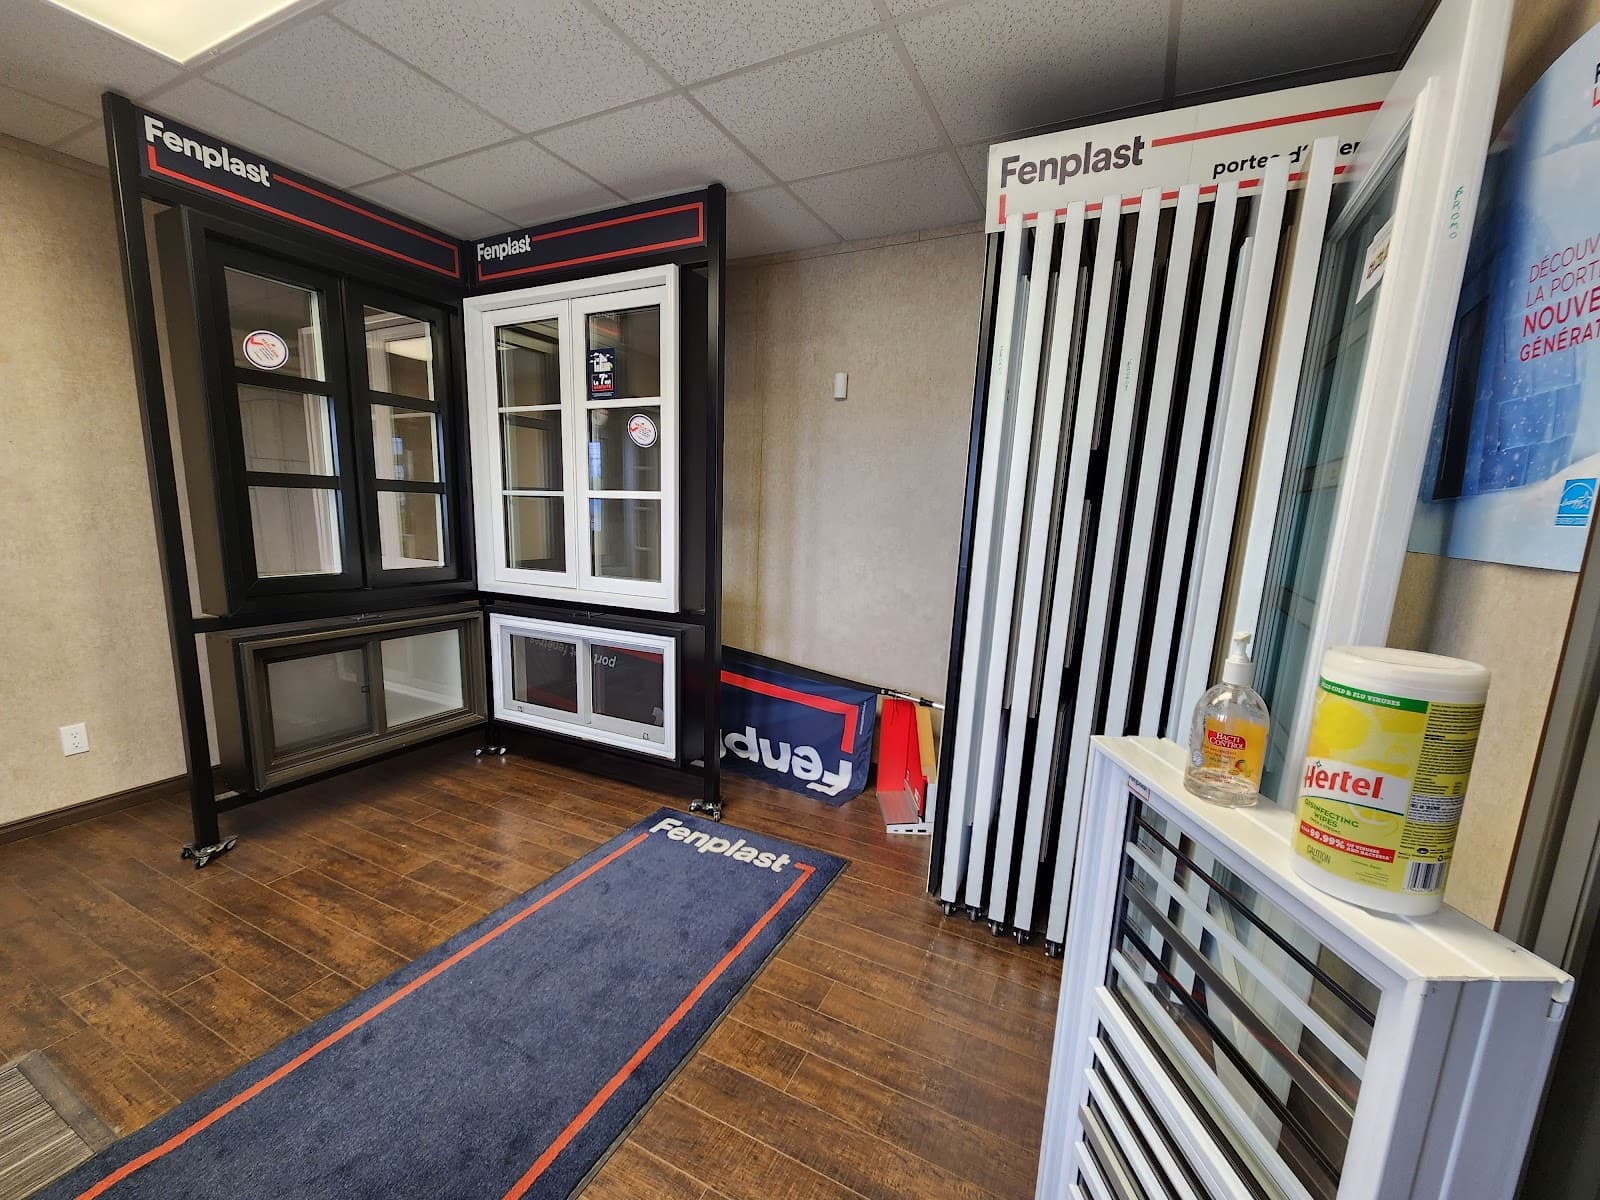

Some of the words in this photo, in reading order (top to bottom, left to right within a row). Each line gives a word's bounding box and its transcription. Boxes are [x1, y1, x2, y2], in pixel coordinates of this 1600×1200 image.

[144, 115, 271, 188] Fenplast
[1000, 135, 1145, 188] Fenplast
[1212, 154, 1280, 180] porte
[477, 234, 531, 262] Fenplast
[1525, 284, 1545, 308] LA
[1550, 259, 1600, 298] PORT
[593, 653, 617, 668] port
[1209, 737, 1243, 749] CONTROL
[1217, 733, 1240, 743] BACTI
[1304, 764, 1384, 799] Hertel
[1305, 798, 1360, 828] DISINFECTING
[649, 817, 790, 873] Fenplast
[1310, 828, 1345, 850] 99.99%
